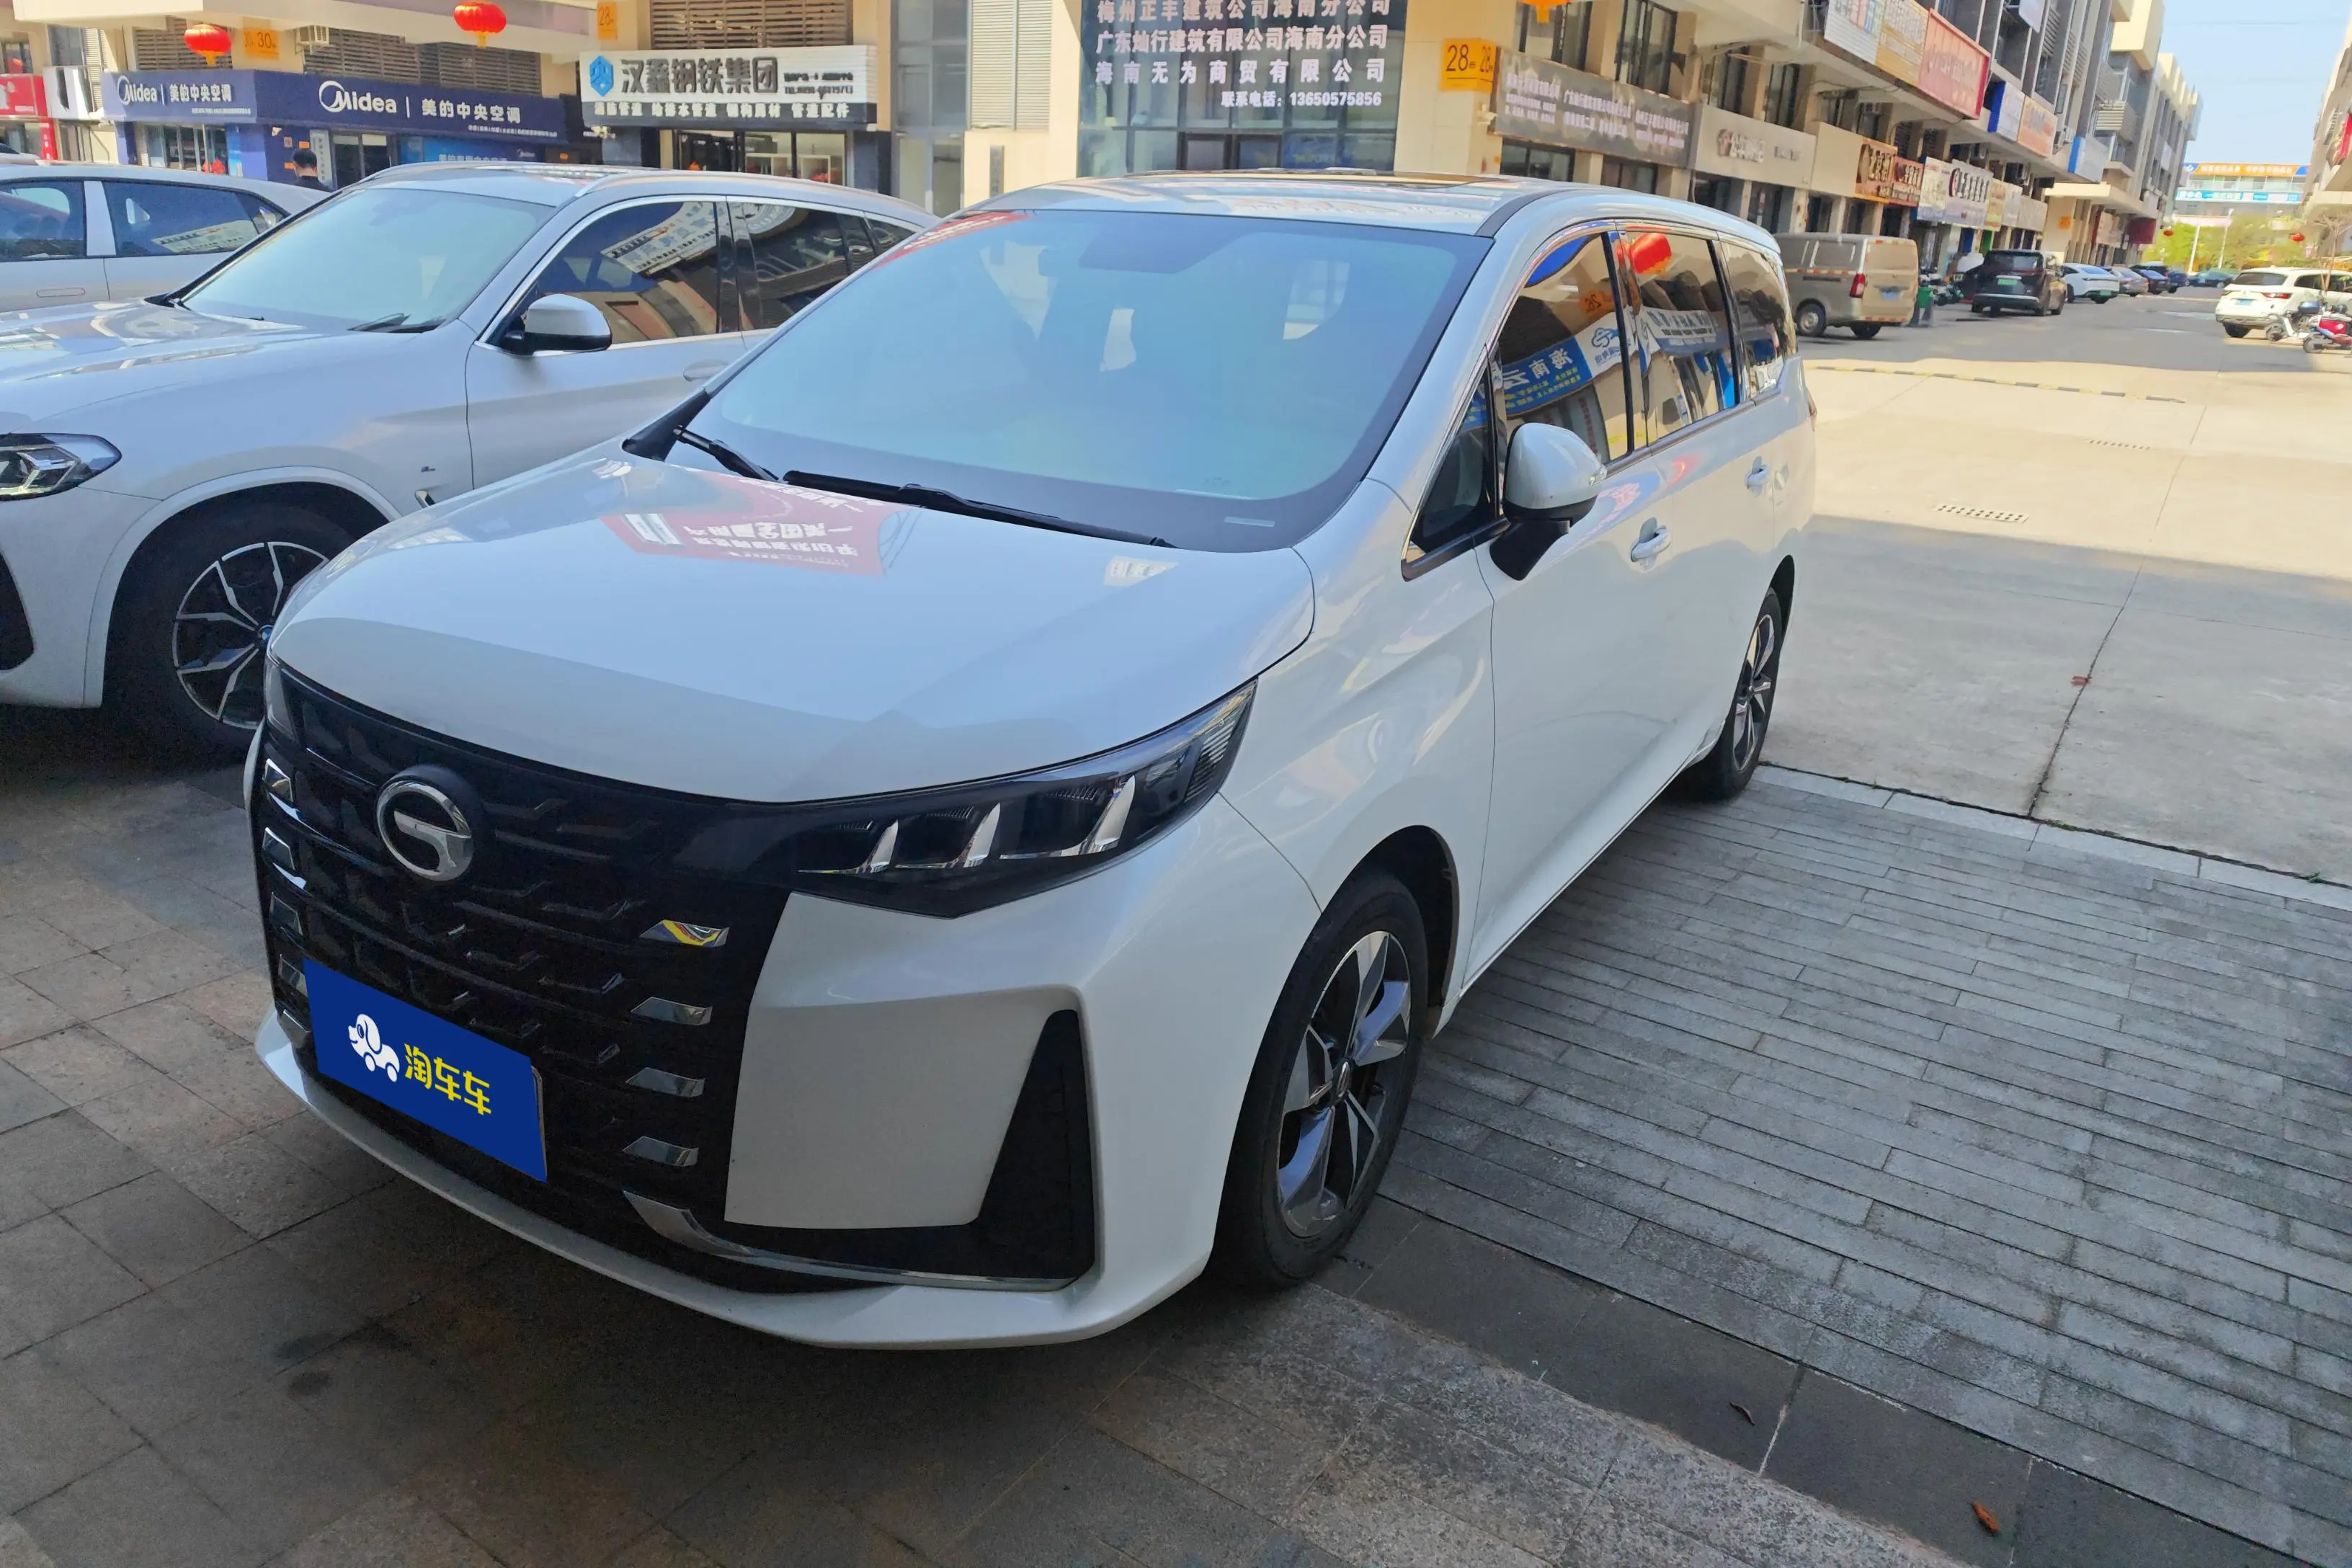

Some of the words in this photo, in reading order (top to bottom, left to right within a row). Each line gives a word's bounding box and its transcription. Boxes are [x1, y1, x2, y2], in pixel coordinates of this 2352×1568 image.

[1095, 58, 1385, 84] 海南无为商贸有限公司
[117, 75, 157, 105] Midea
[169, 83, 232, 102] 美的中央空调
[318, 80, 397, 112] Midea
[422, 98, 521, 124] 美的中央空调
